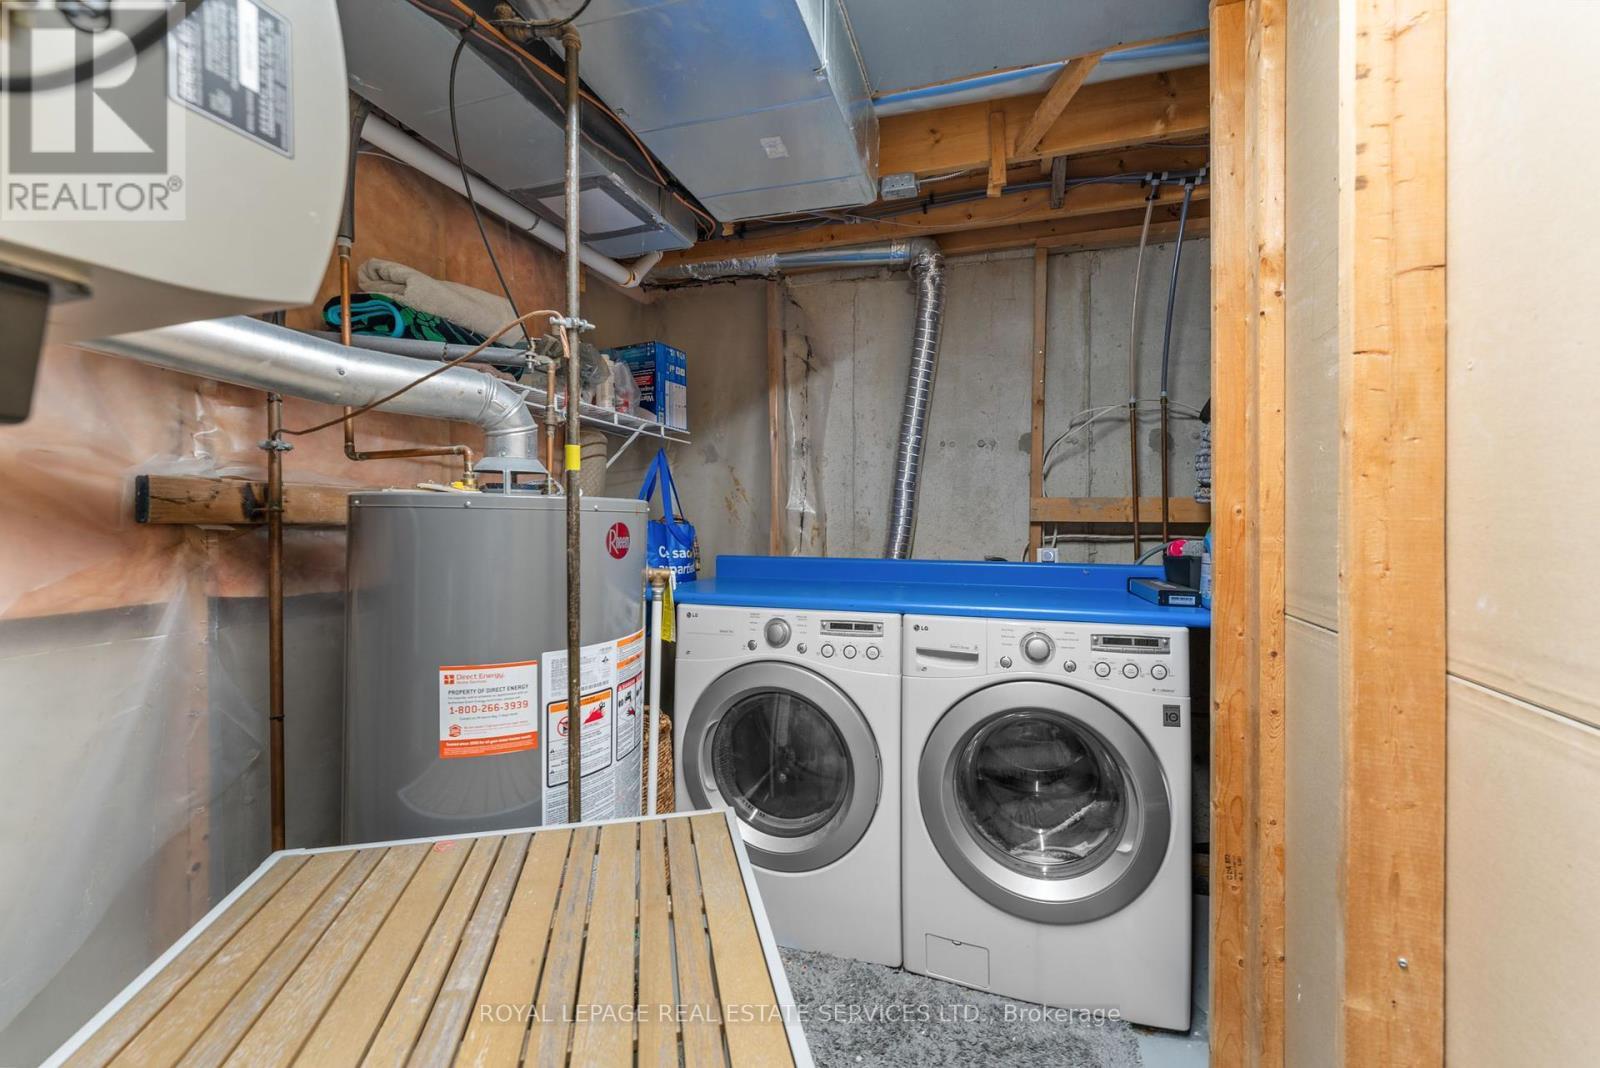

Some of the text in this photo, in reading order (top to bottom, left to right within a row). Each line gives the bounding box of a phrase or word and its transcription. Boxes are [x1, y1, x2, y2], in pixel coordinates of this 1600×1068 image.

[609, 522, 631, 554] Rheem
[447, 688, 476, 696] PROPERTY
[477, 687, 485, 695] OF
[486, 685, 506, 694] DIRECT
[506, 683, 529, 692] ENERGY
[449, 699, 529, 715] 1-800-266-3939
